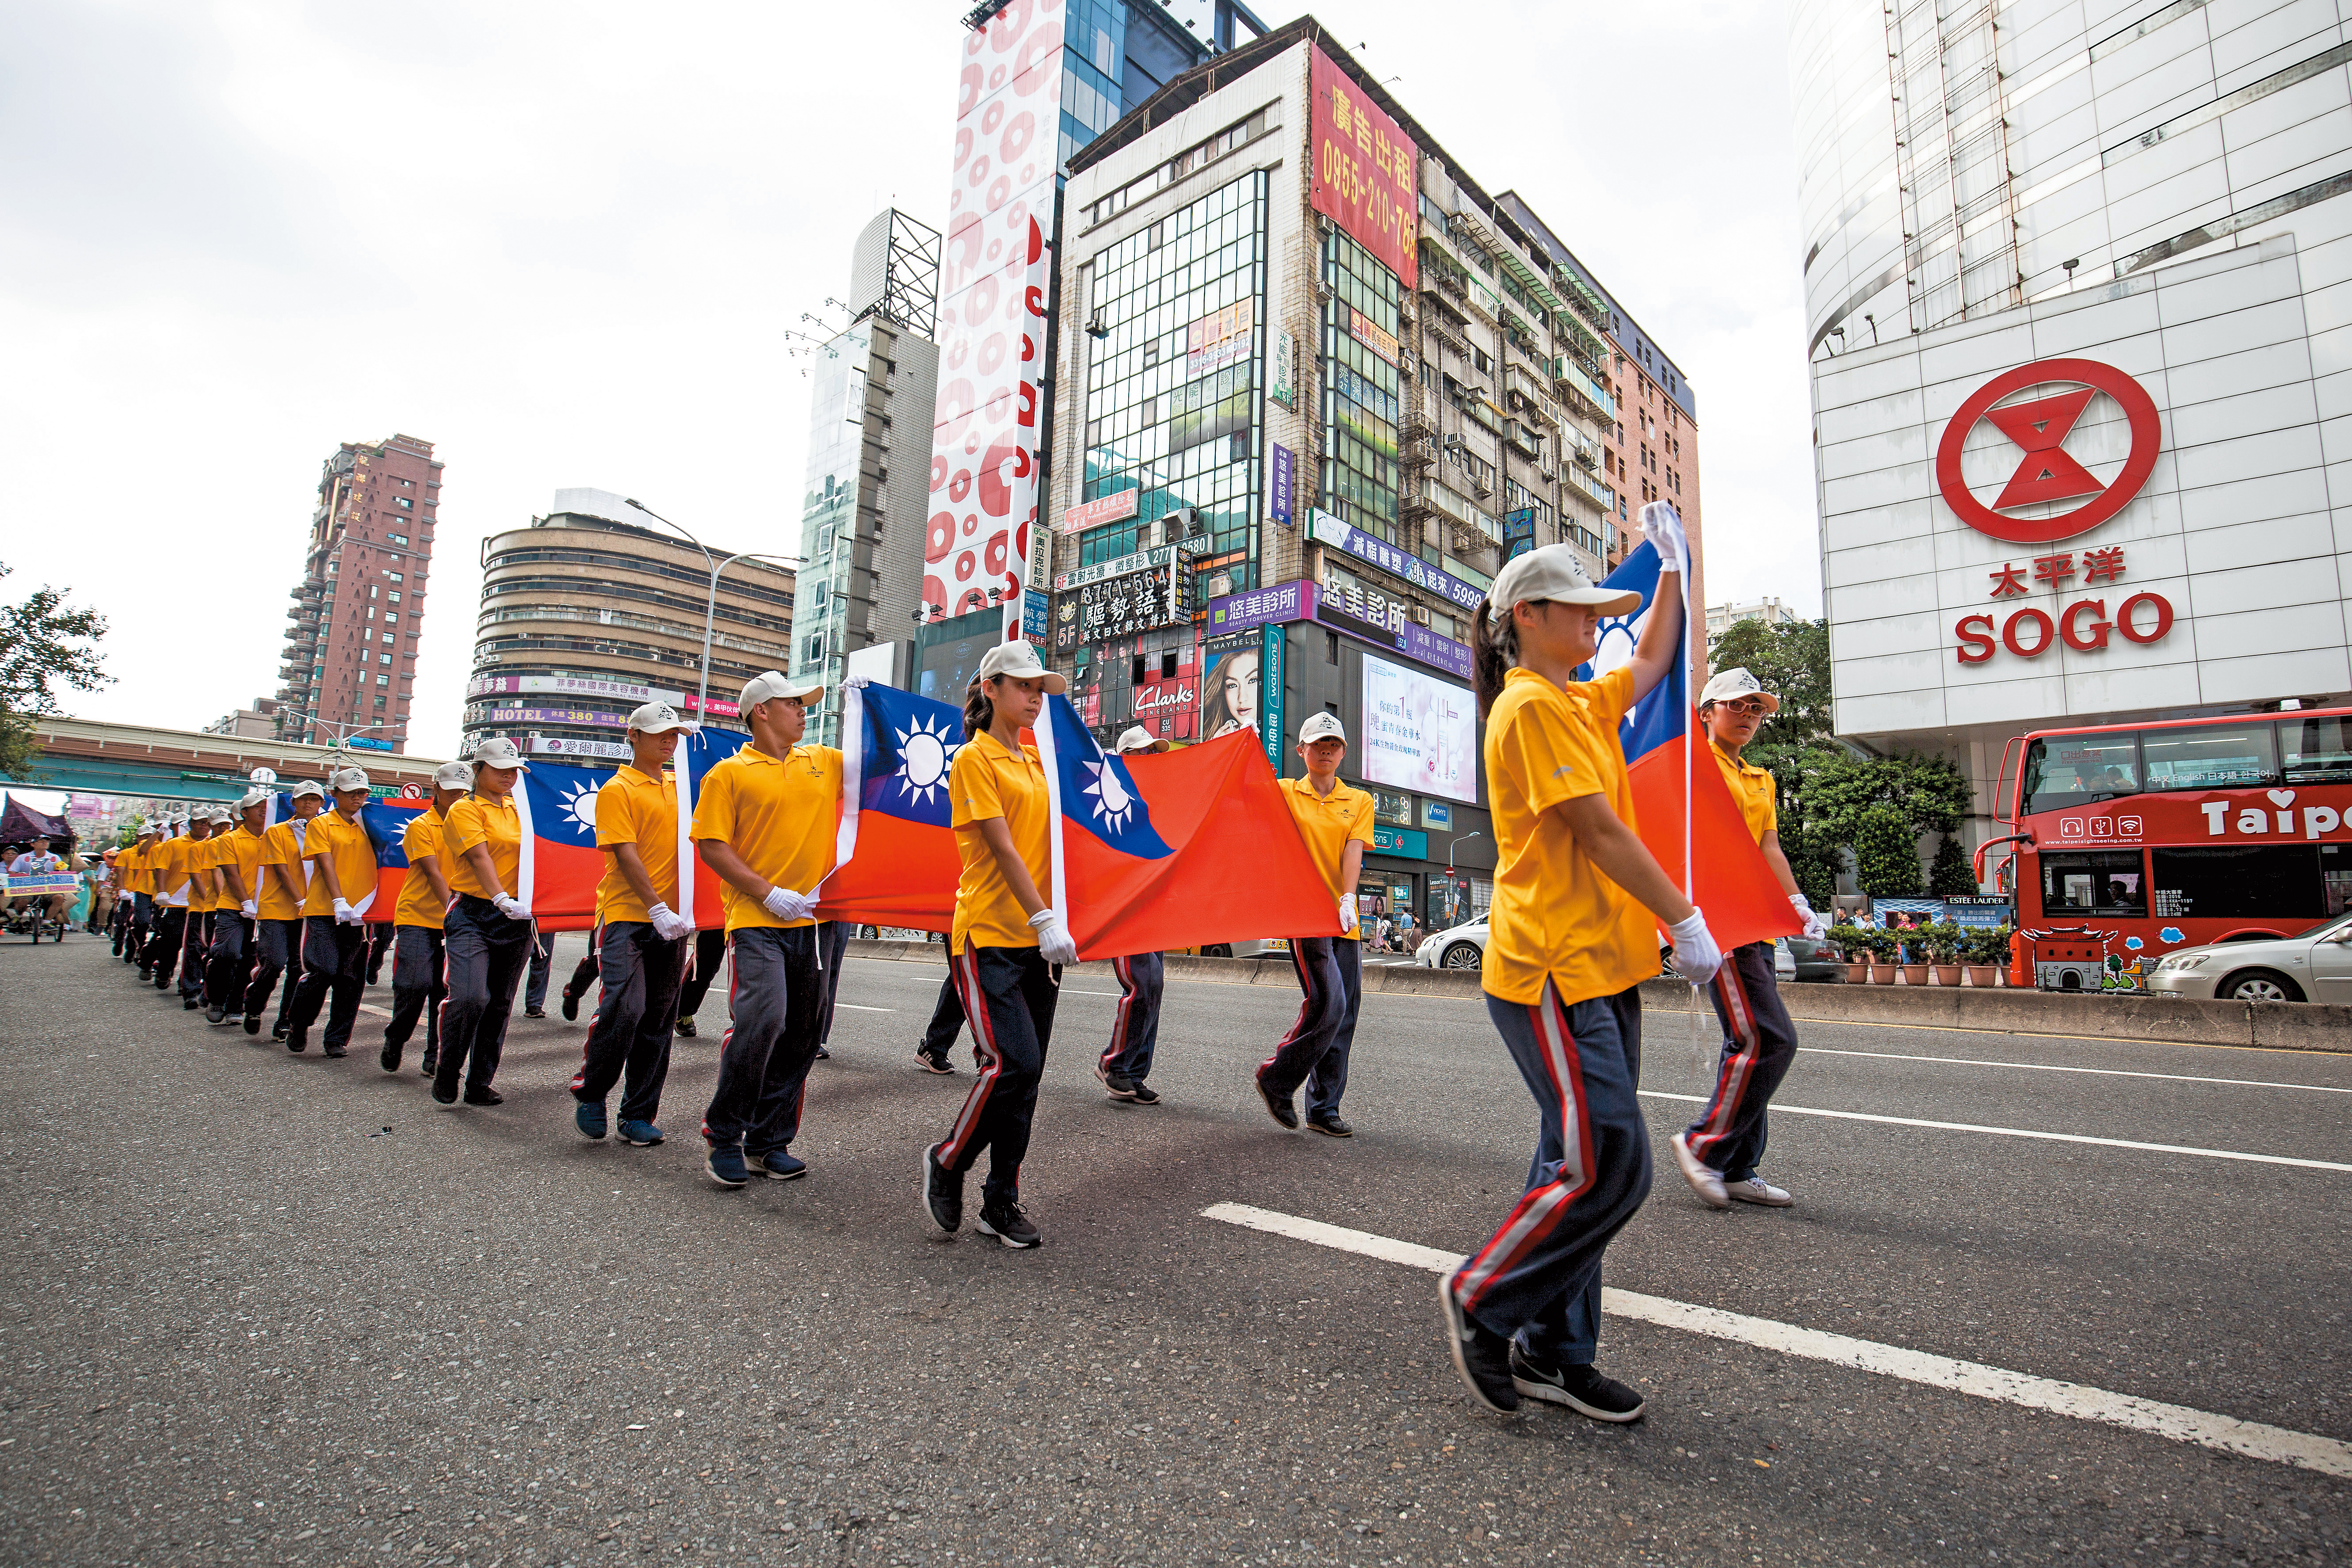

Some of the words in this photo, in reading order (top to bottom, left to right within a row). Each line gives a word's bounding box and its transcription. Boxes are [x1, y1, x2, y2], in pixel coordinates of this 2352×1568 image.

[1332, 84, 1412, 196] 廣告出租
[1324, 139, 1415, 260] 0955-210-789
[1277, 331, 1290, 390] 光能身心診所
[1282, 392, 1291, 406] 8F
[1277, 458, 1287, 511] 悠美診所
[1087, 491, 1133, 515] 專業熱蠟除毛
[1034, 527, 1049, 538] Oracle
[1034, 537, 1045, 588] 奧拉克診所
[1989, 546, 2126, 597] 太平洋
[1057, 575, 1066, 588] 6F
[1082, 567, 1170, 604] 8771-564
[1229, 587, 1296, 620] 悠美診所
[1321, 572, 1406, 636] 悠美診所
[1229, 618, 1247, 627] BEAUTY
[1249, 614, 1273, 622] FOREVER
[1955, 592, 2174, 663] SOGO
[1058, 624, 1075, 646] 5F
[1417, 631, 1430, 647] 減重
[1436, 639, 1449, 654] 雷射
[1455, 647, 1467, 661] 整形
[557, 679, 649, 696] 菲夢絲國際美容機構
[581, 690, 626, 699] INTERNATIONAL
[1135, 683, 1194, 710] Clarks
[493, 710, 545, 721] HOTEL
[567, 711, 593, 721] 380
[1143, 705, 1187, 716] ENGLAND
[1380, 696, 1412, 721] 你的第1瓶
[1269, 713, 1277, 756] 屈臣氏
[564, 741, 634, 757] 愛爾麗診所
[2173, 773, 2205, 783] English
[2208, 771, 2237, 781] 日本語
[2241, 770, 2270, 778] 한국어
[2201, 790, 2352, 839] Taip
